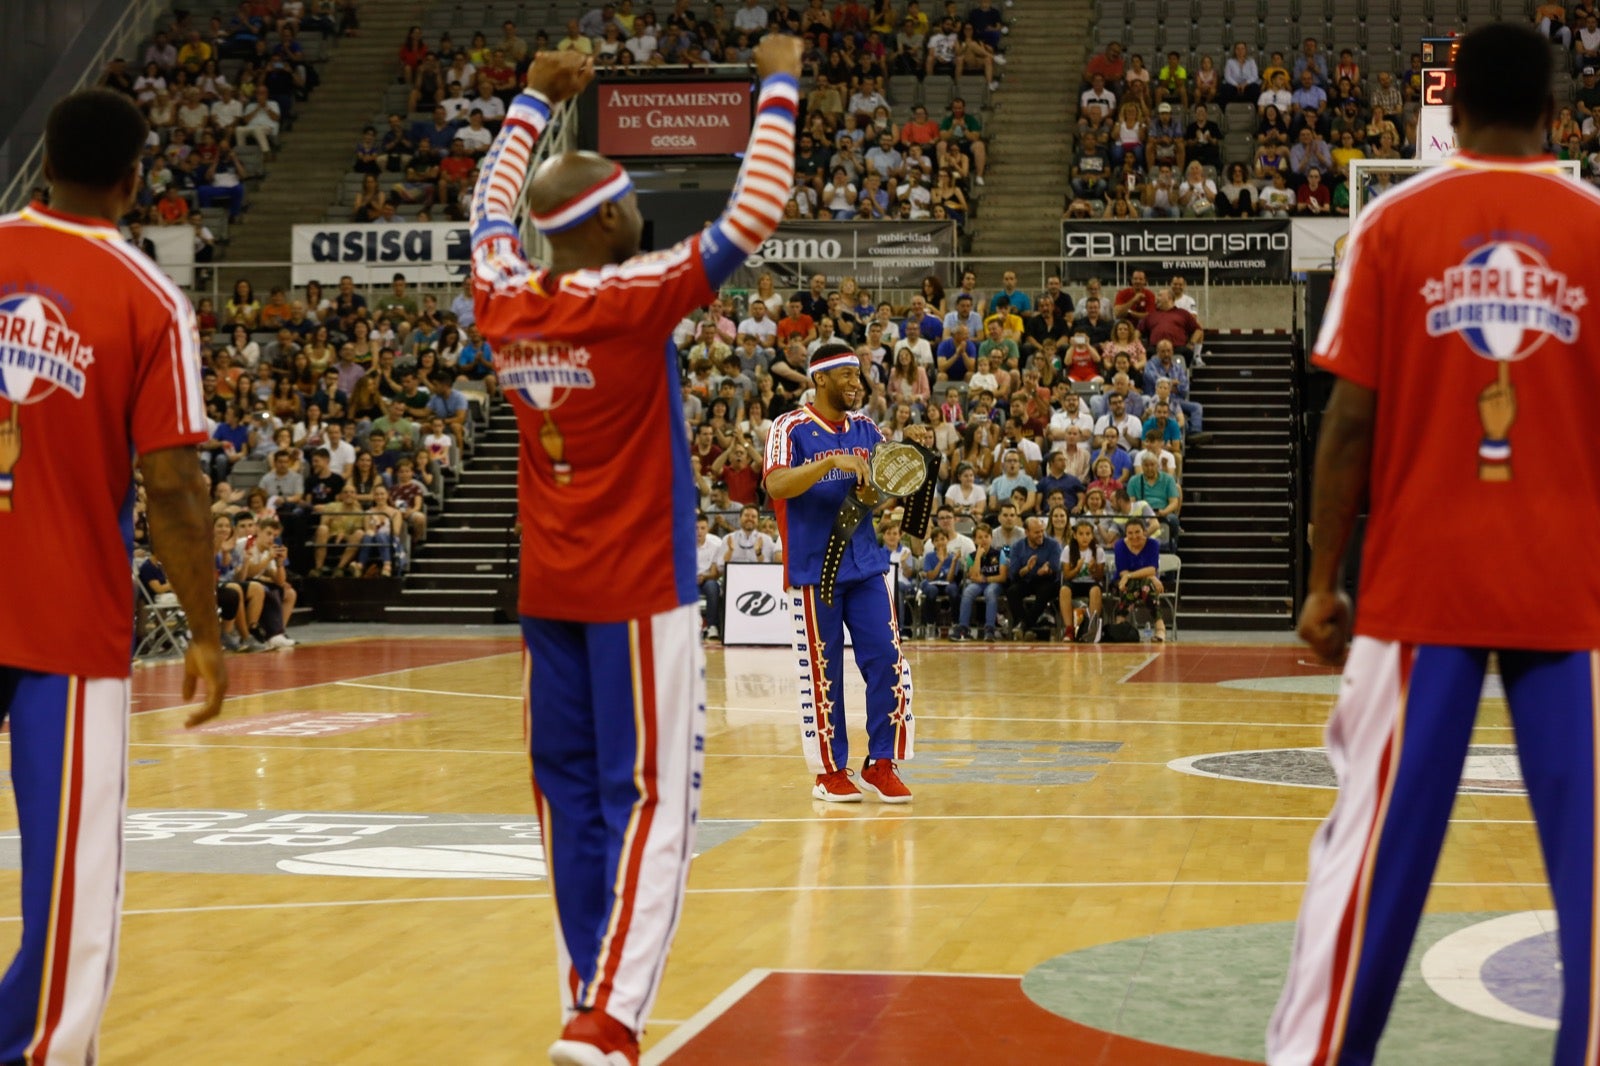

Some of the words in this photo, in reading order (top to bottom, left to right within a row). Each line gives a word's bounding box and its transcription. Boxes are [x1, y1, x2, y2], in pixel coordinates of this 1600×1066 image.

[608, 89, 742, 107] AYUNTAMIENTO
[618, 116, 641, 128] DE
[646, 110, 730, 128] GRANADA
[311, 230, 432, 262] asisa
[877, 232, 931, 244] publicidad
[1120, 230, 1288, 255] interiorismo
[868, 245, 939, 255] comunicación
[1162, 260, 1173, 269] BY
[1208, 260, 1266, 269] BALLESTEROS
[1446, 267, 1564, 307] HARLEM
[0, 346, 85, 395] TROTTERS
